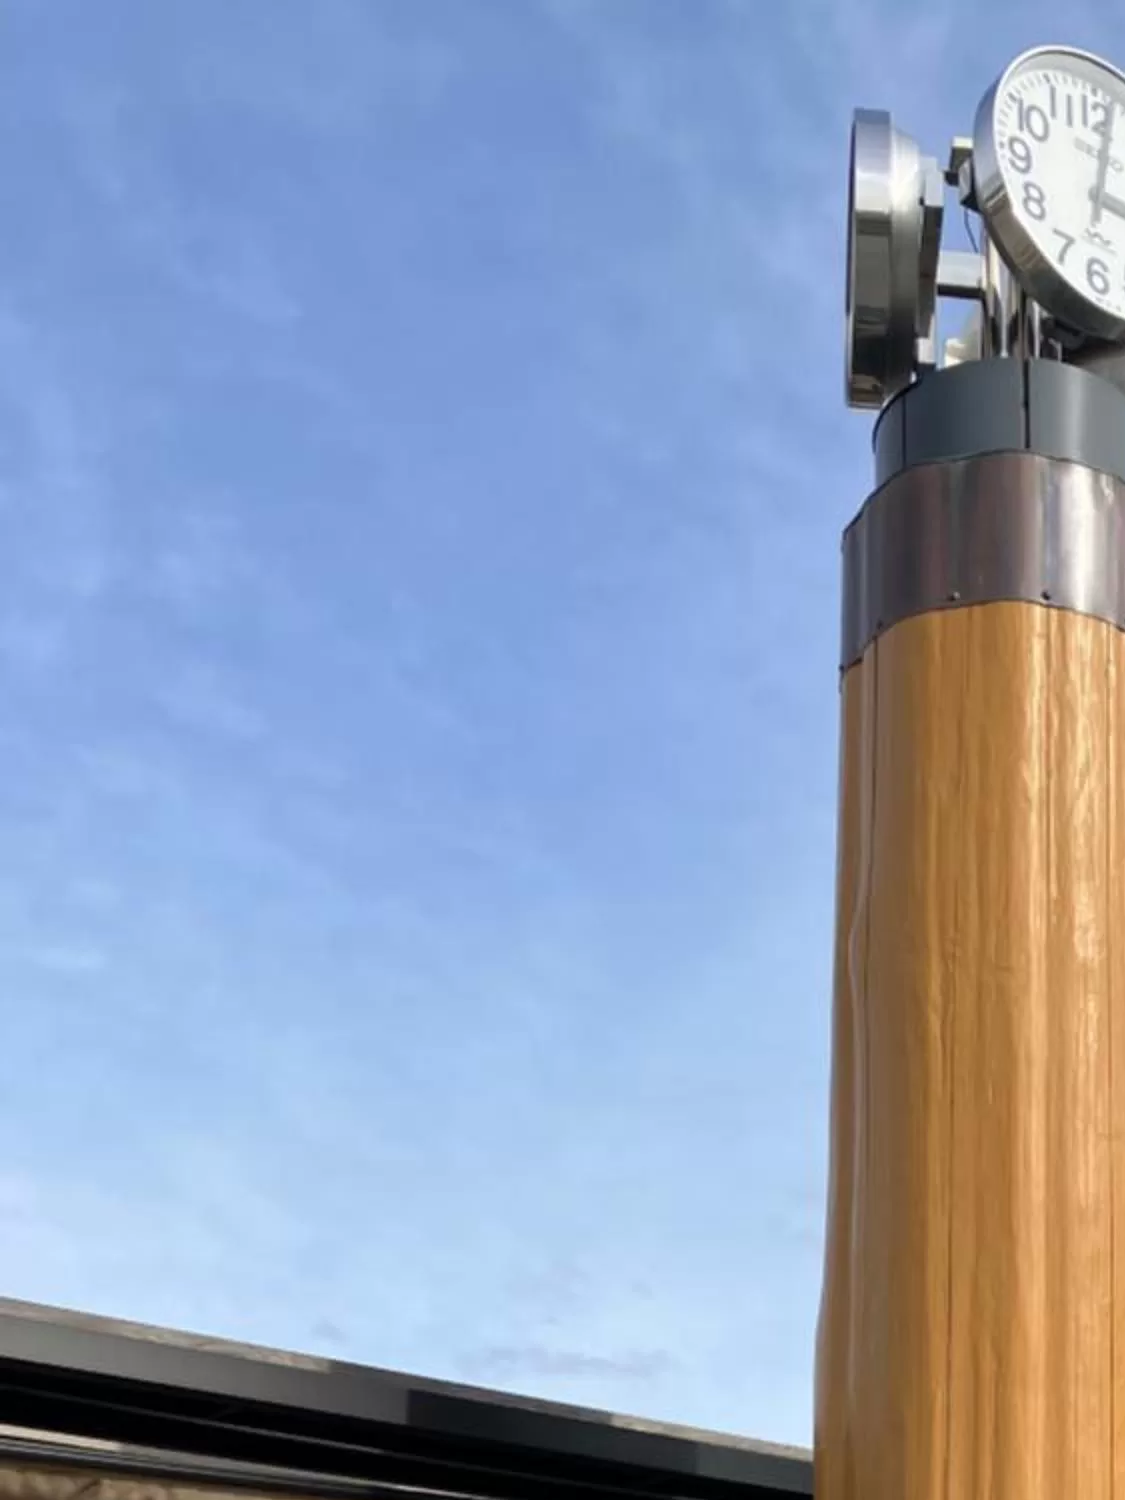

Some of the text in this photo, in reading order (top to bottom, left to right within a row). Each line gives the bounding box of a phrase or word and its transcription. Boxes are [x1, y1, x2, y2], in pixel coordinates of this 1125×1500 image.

[1018, 99, 1049, 142] 10
[1008, 136, 1032, 174] 9
[1022, 182, 1046, 221] 8
[1052, 228, 1075, 266] 7
[1086, 257, 1109, 296] 6
